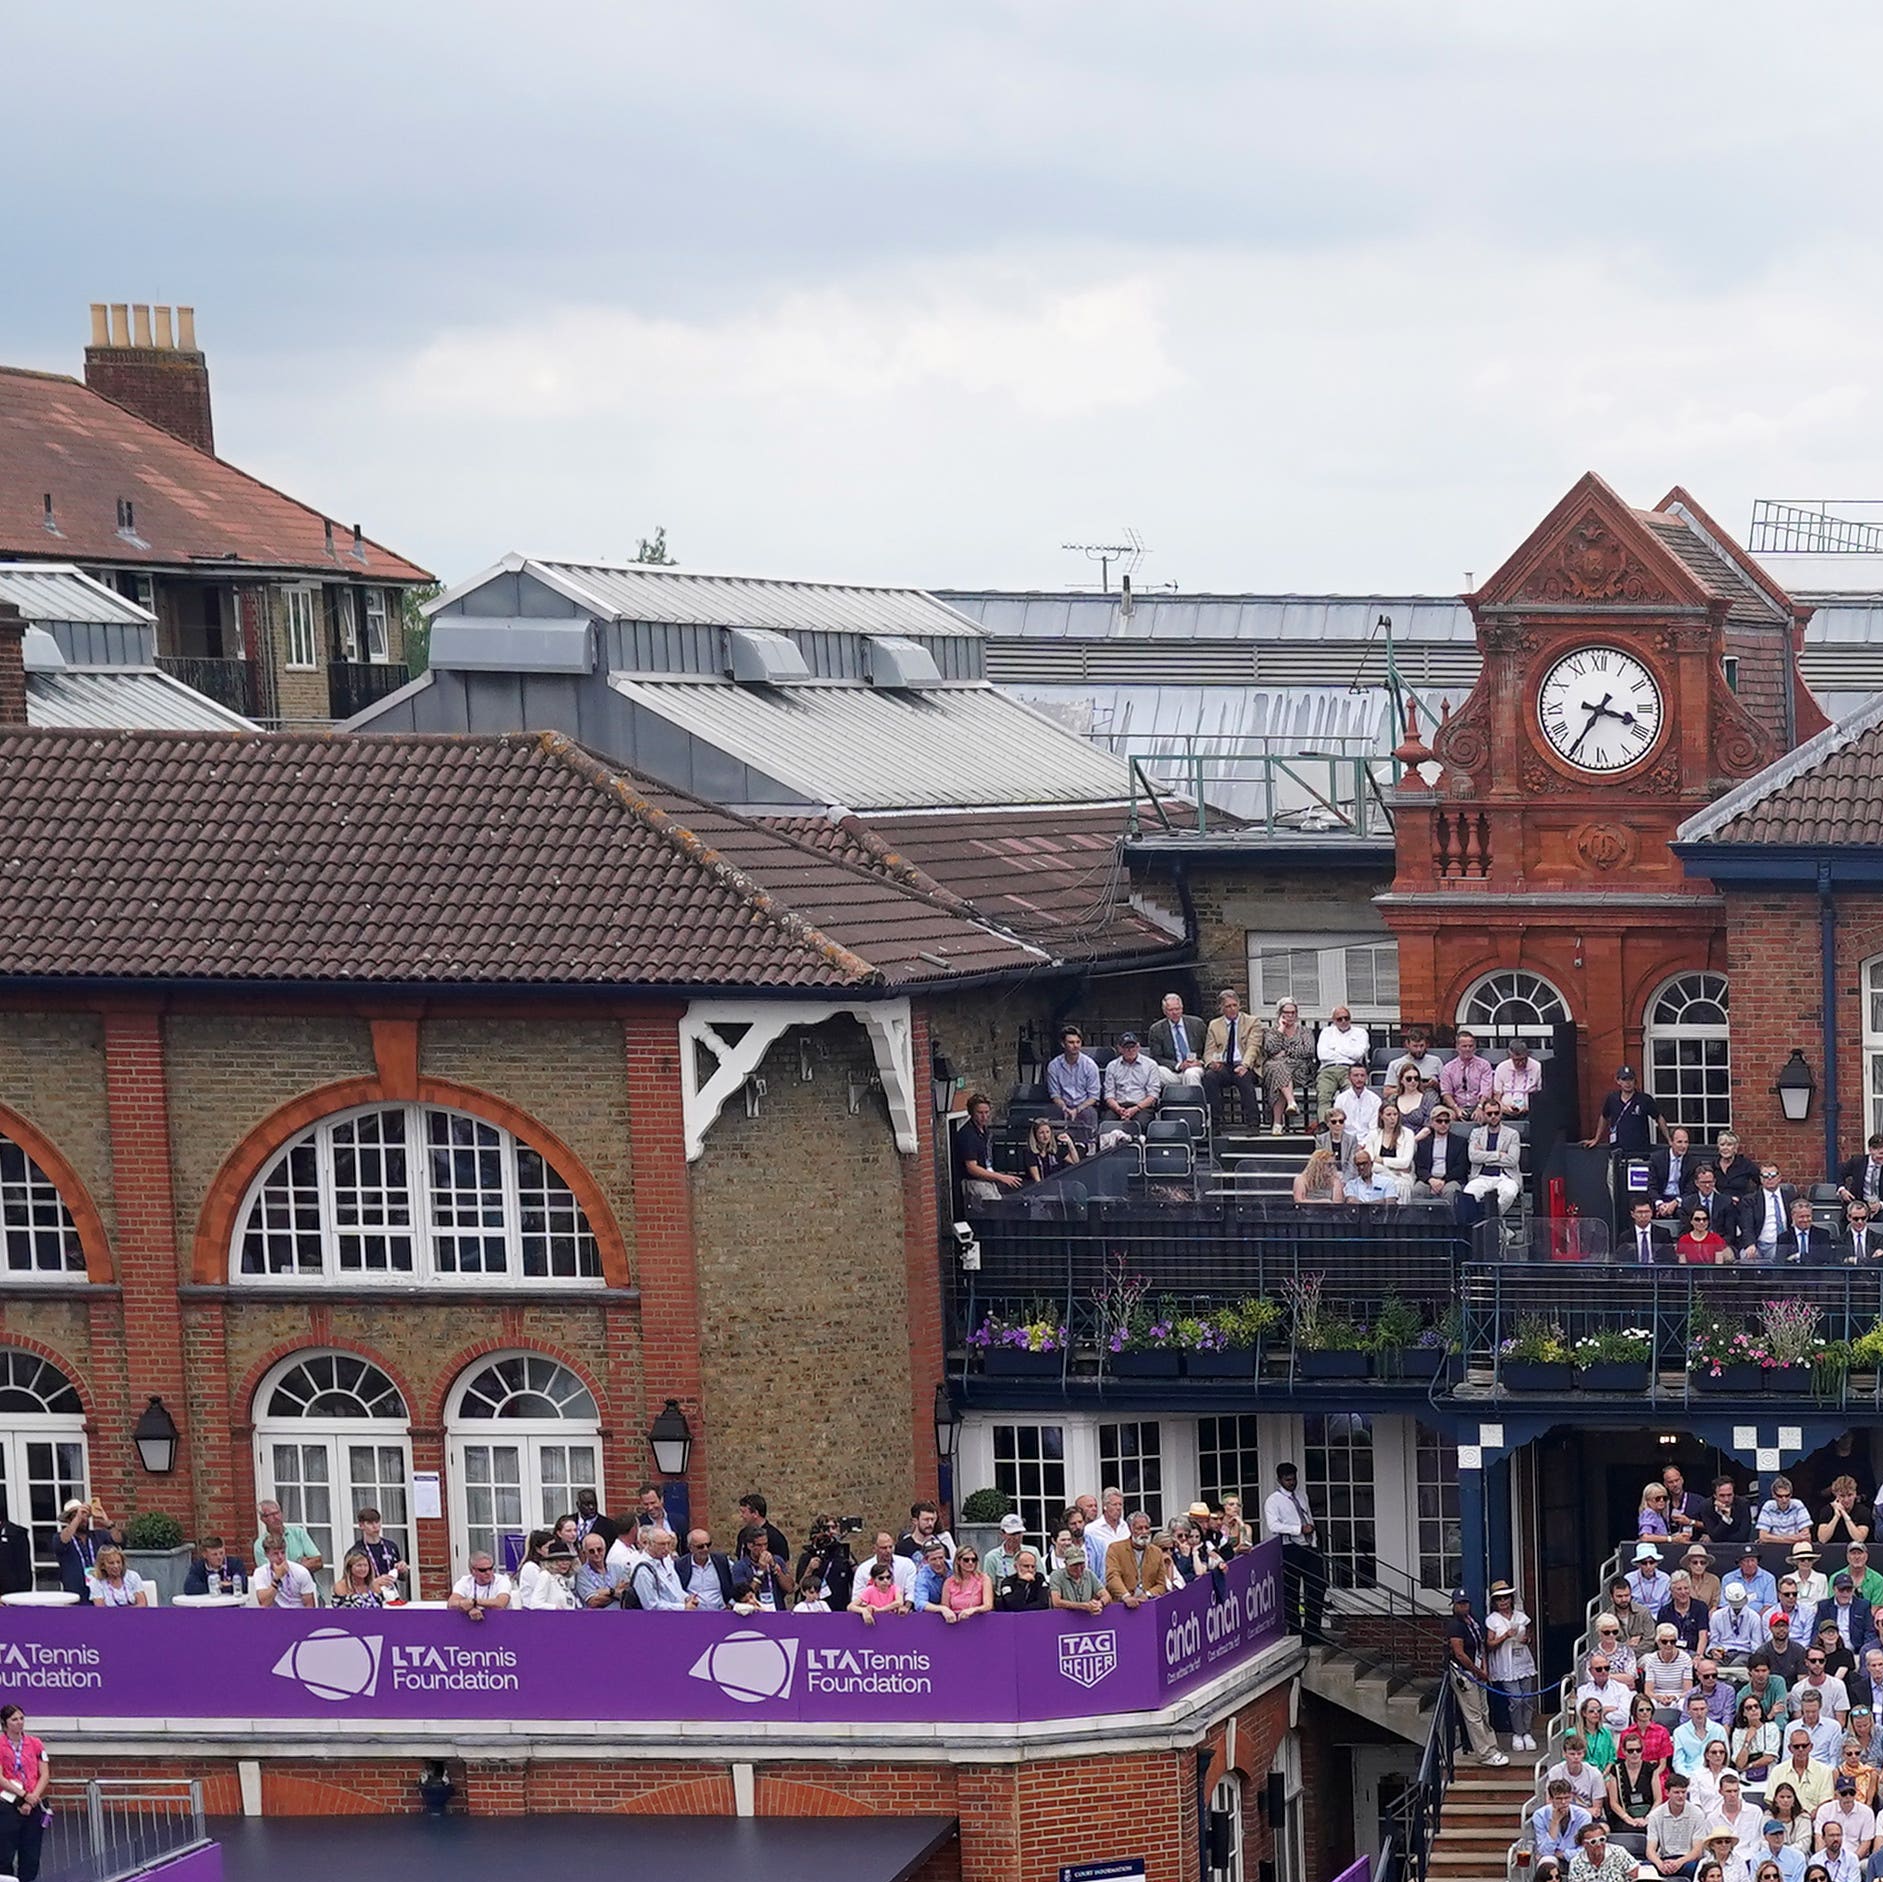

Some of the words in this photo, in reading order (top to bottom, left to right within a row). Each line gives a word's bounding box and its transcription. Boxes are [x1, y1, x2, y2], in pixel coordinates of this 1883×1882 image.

[1568, 660, 1586, 676] XI
[1591, 656, 1607, 672] XII
[1617, 663, 1626, 677] I
[1630, 680, 1646, 692] II
[1637, 704, 1653, 714] III
[1246, 1570, 1275, 1621] cinch
[1206, 1590, 1240, 1643] cinch
[1063, 1635, 1110, 1654] TAG
[1166, 1611, 1200, 1665] cinch
[25, 1643, 100, 1665] Tennis
[392, 1645, 445, 1671] LTA
[444, 1644, 516, 1667] Tennis
[808, 1649, 862, 1674] LTA
[860, 1649, 929, 1670] Tennis
[0, 1667, 102, 1688] undation
[394, 1668, 517, 1690] Foundation
[1064, 1656, 1113, 1683] HEUER
[809, 1670, 931, 1693] Foundation
